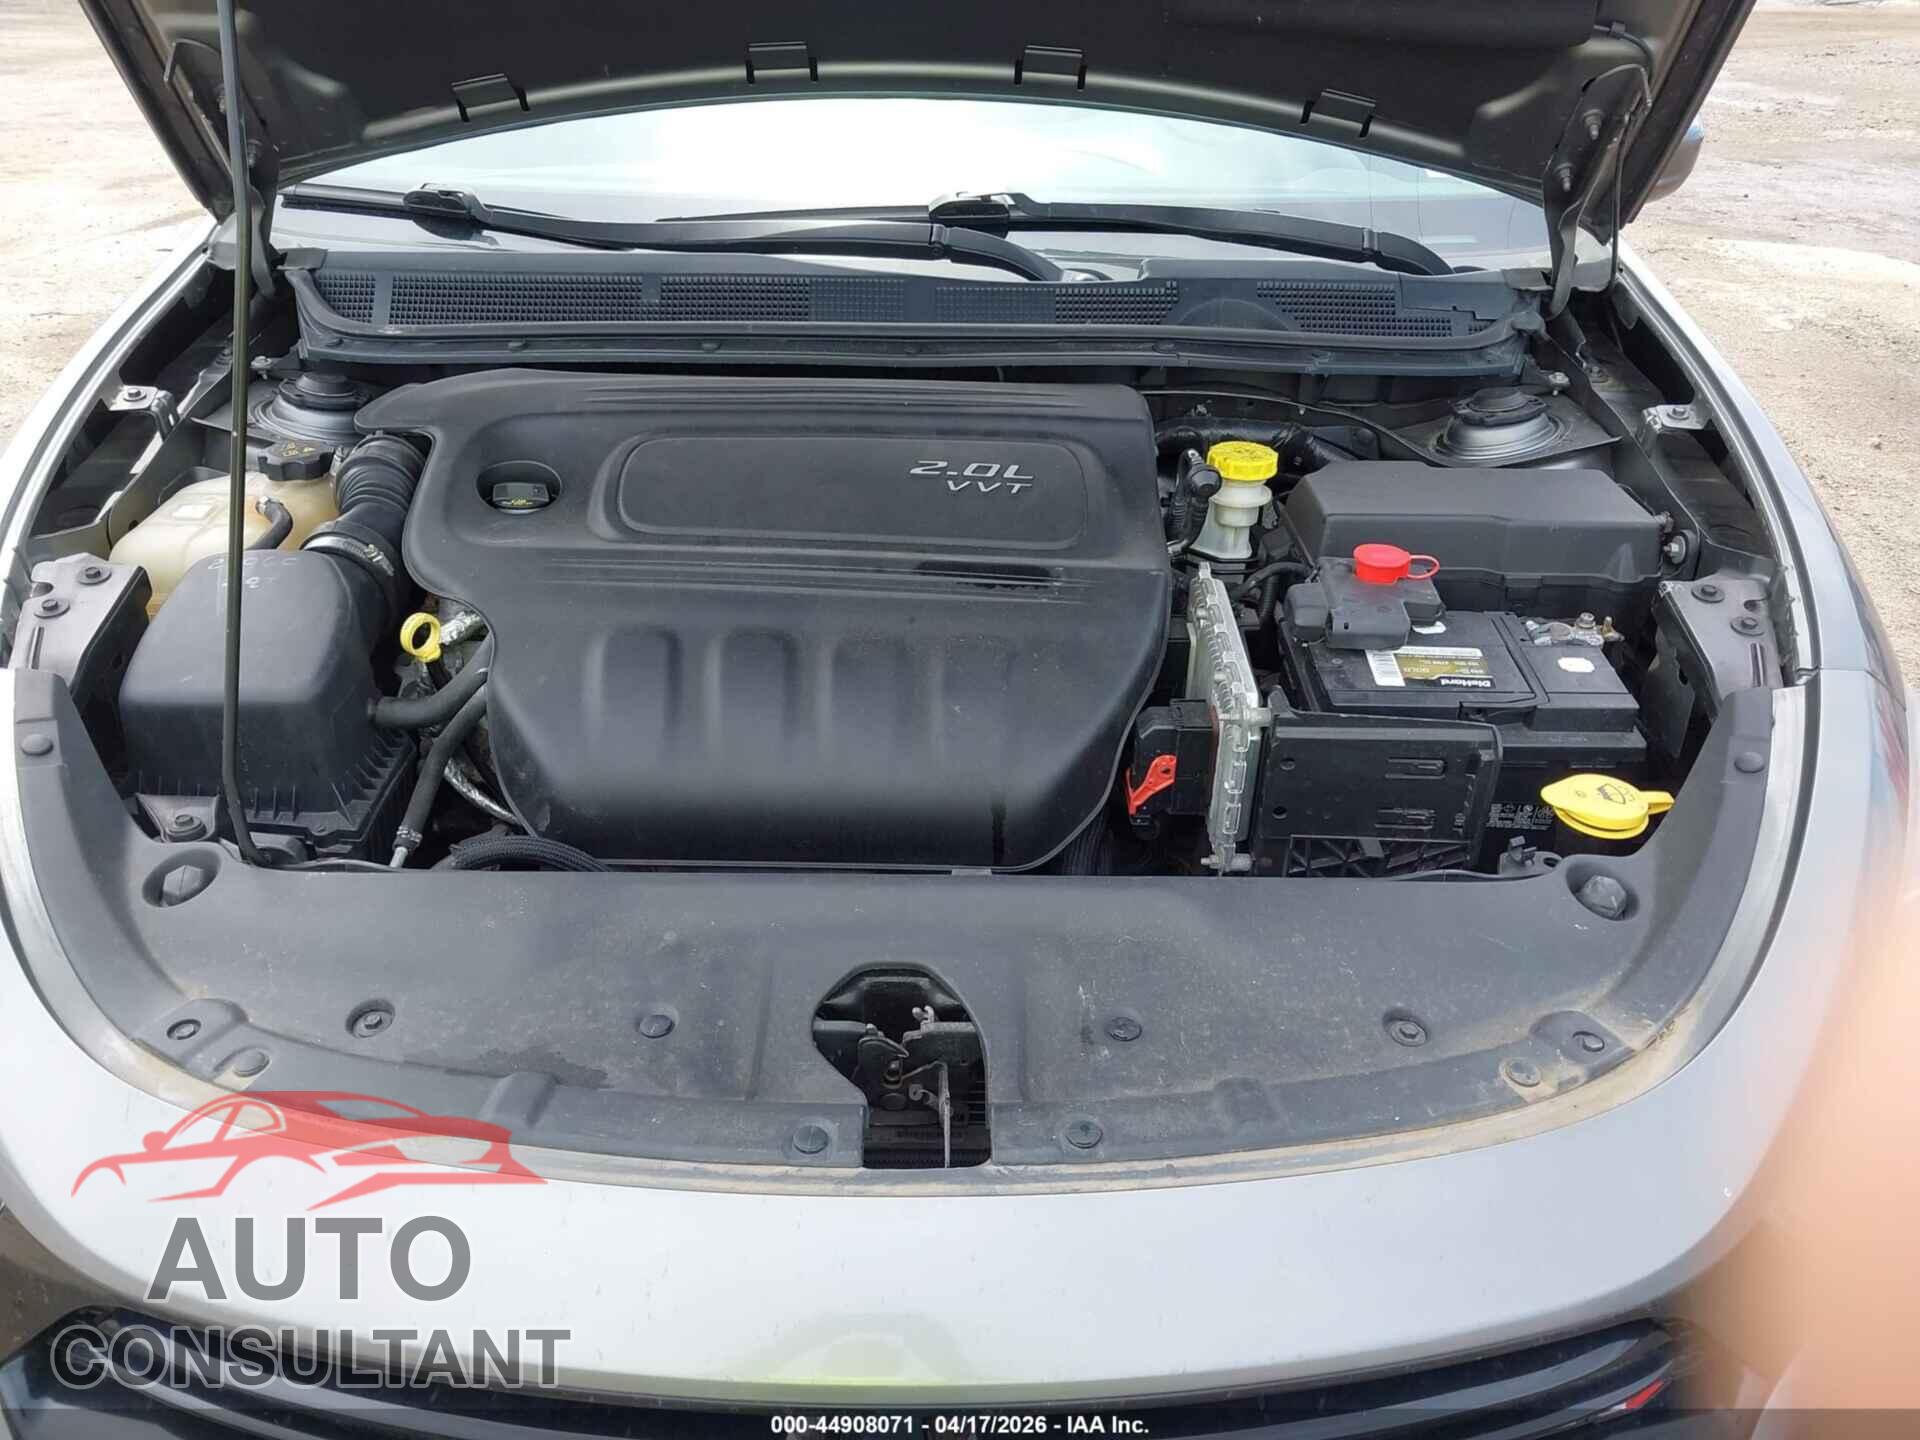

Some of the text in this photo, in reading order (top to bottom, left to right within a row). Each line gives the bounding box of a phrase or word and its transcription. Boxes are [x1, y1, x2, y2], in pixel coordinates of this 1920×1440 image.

[909, 459, 1034, 480] 2.0L
[946, 480, 1034, 495] VVT
[1440, 679, 1492, 688] DieHard
